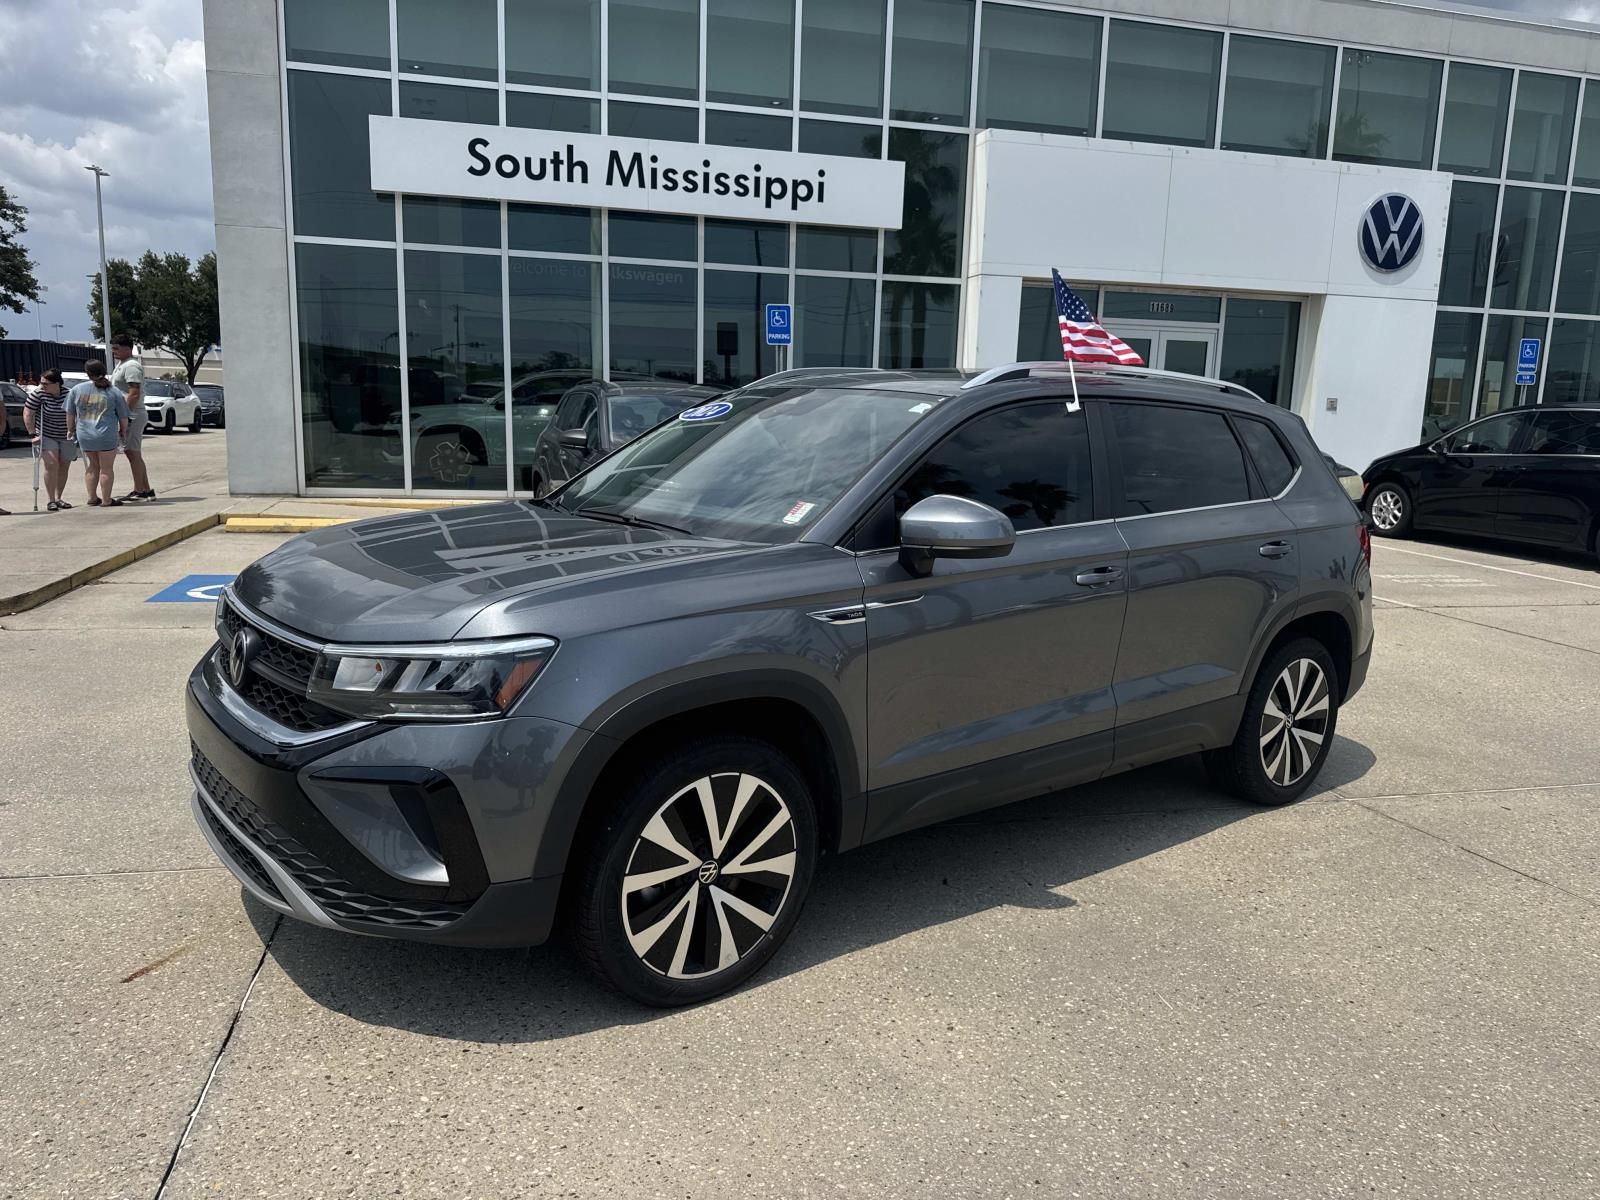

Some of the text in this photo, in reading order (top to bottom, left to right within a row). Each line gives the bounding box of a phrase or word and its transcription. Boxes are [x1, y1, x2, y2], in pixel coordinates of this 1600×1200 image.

[467, 137, 826, 211] South Mississippi
[1357, 192, 1425, 274] VW
[508, 260, 569, 277] elcome
[609, 265, 684, 285] lkswagen
